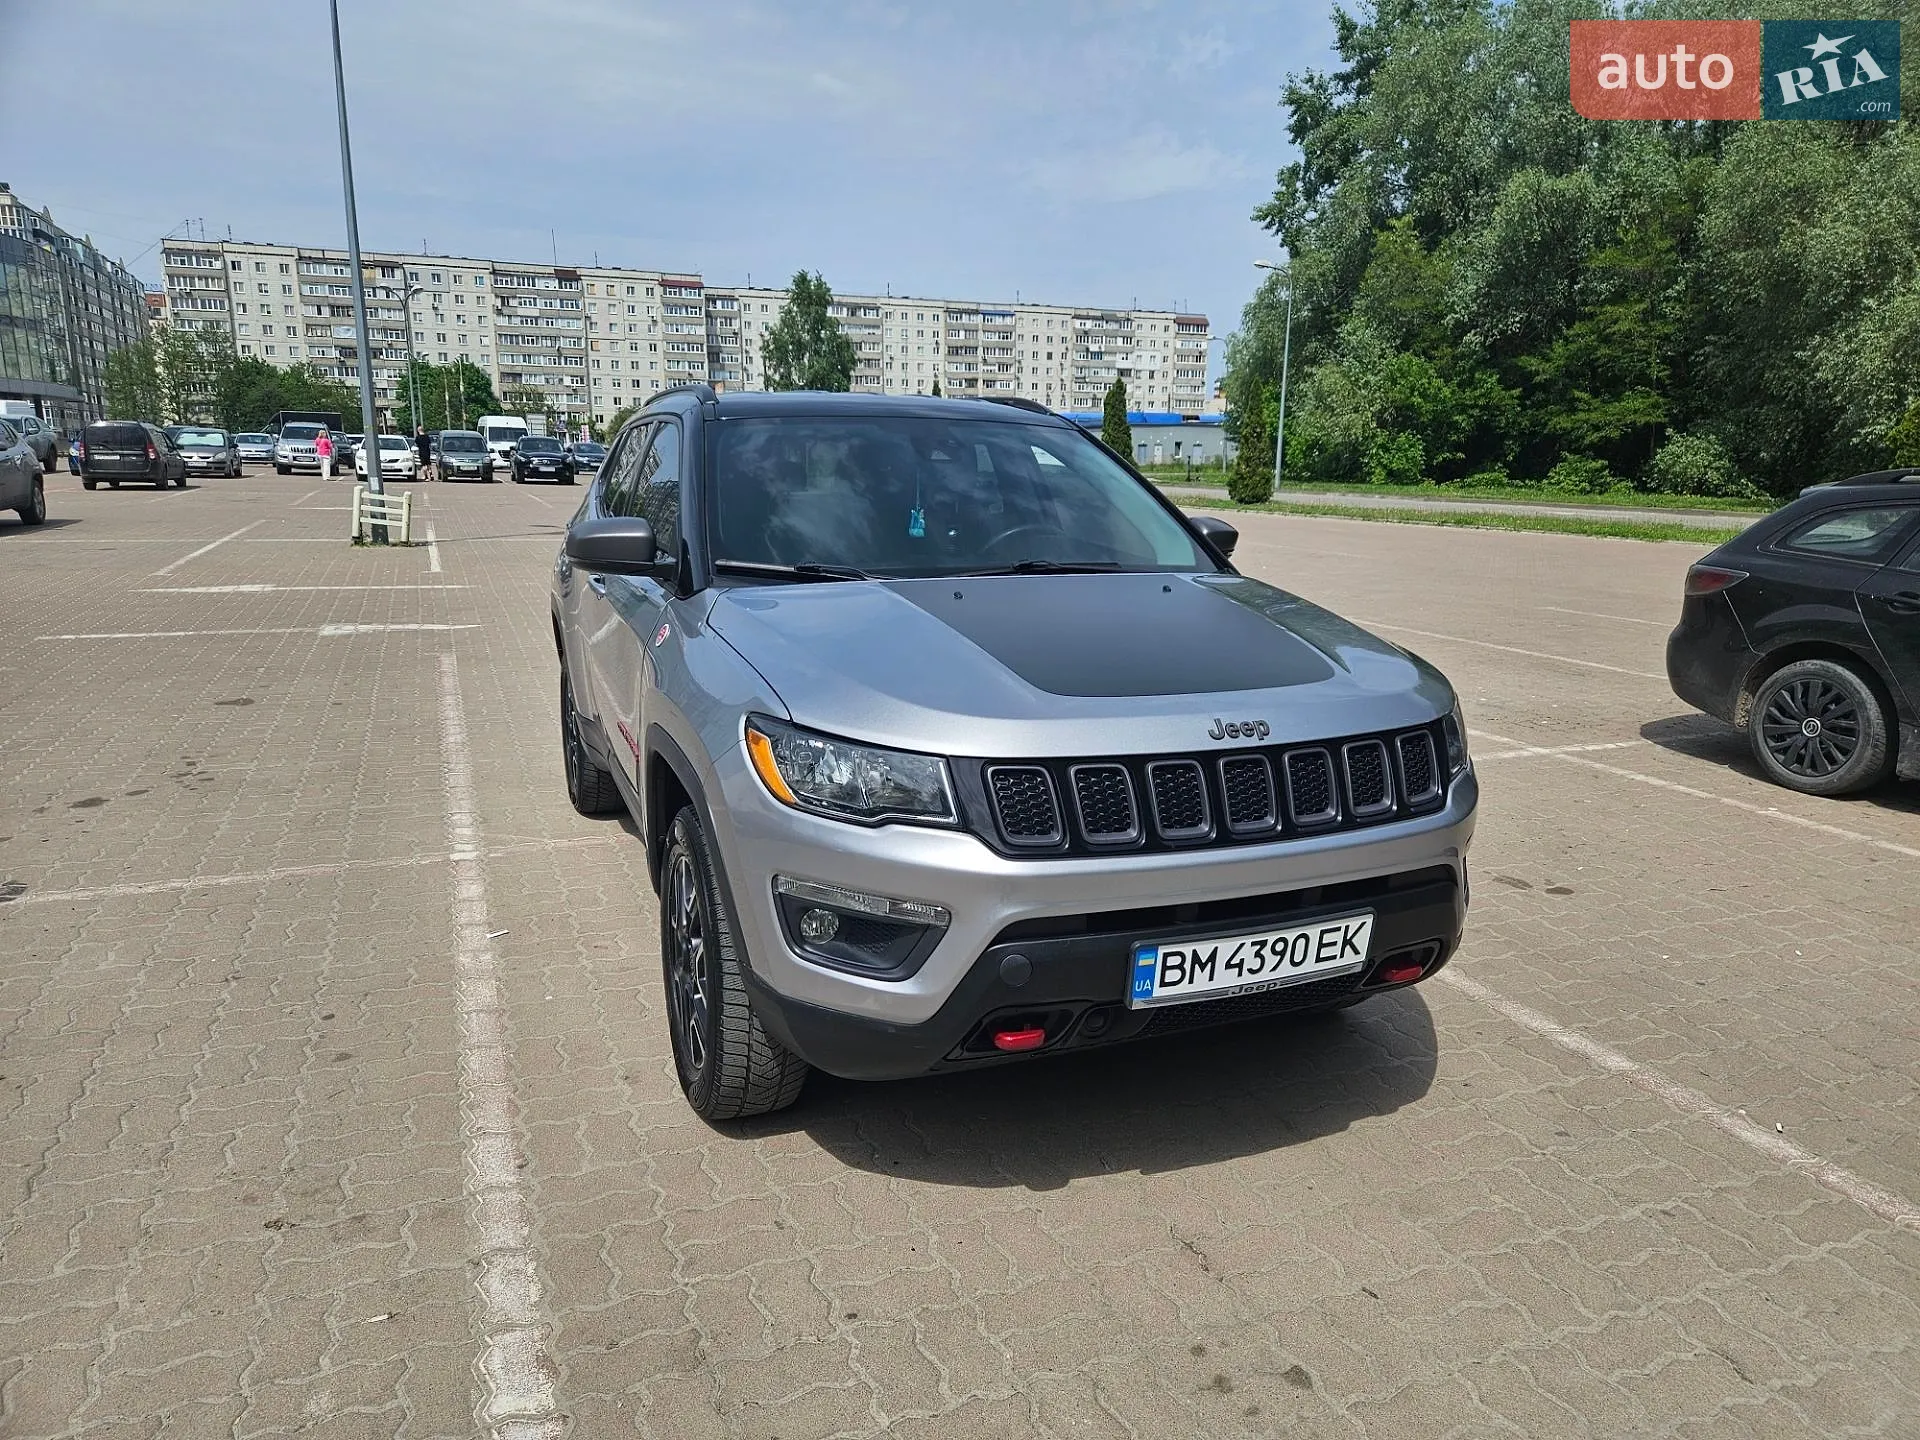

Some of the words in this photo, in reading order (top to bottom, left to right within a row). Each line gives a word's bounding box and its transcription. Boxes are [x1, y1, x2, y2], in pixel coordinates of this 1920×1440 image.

[1208, 718, 1270, 741] Jeep
[1158, 945, 1219, 988] BM
[1224, 932, 1311, 978] 4390
[1314, 921, 1367, 964] EK
[1135, 980, 1152, 992] UA
[1231, 982, 1277, 995] Jeep
